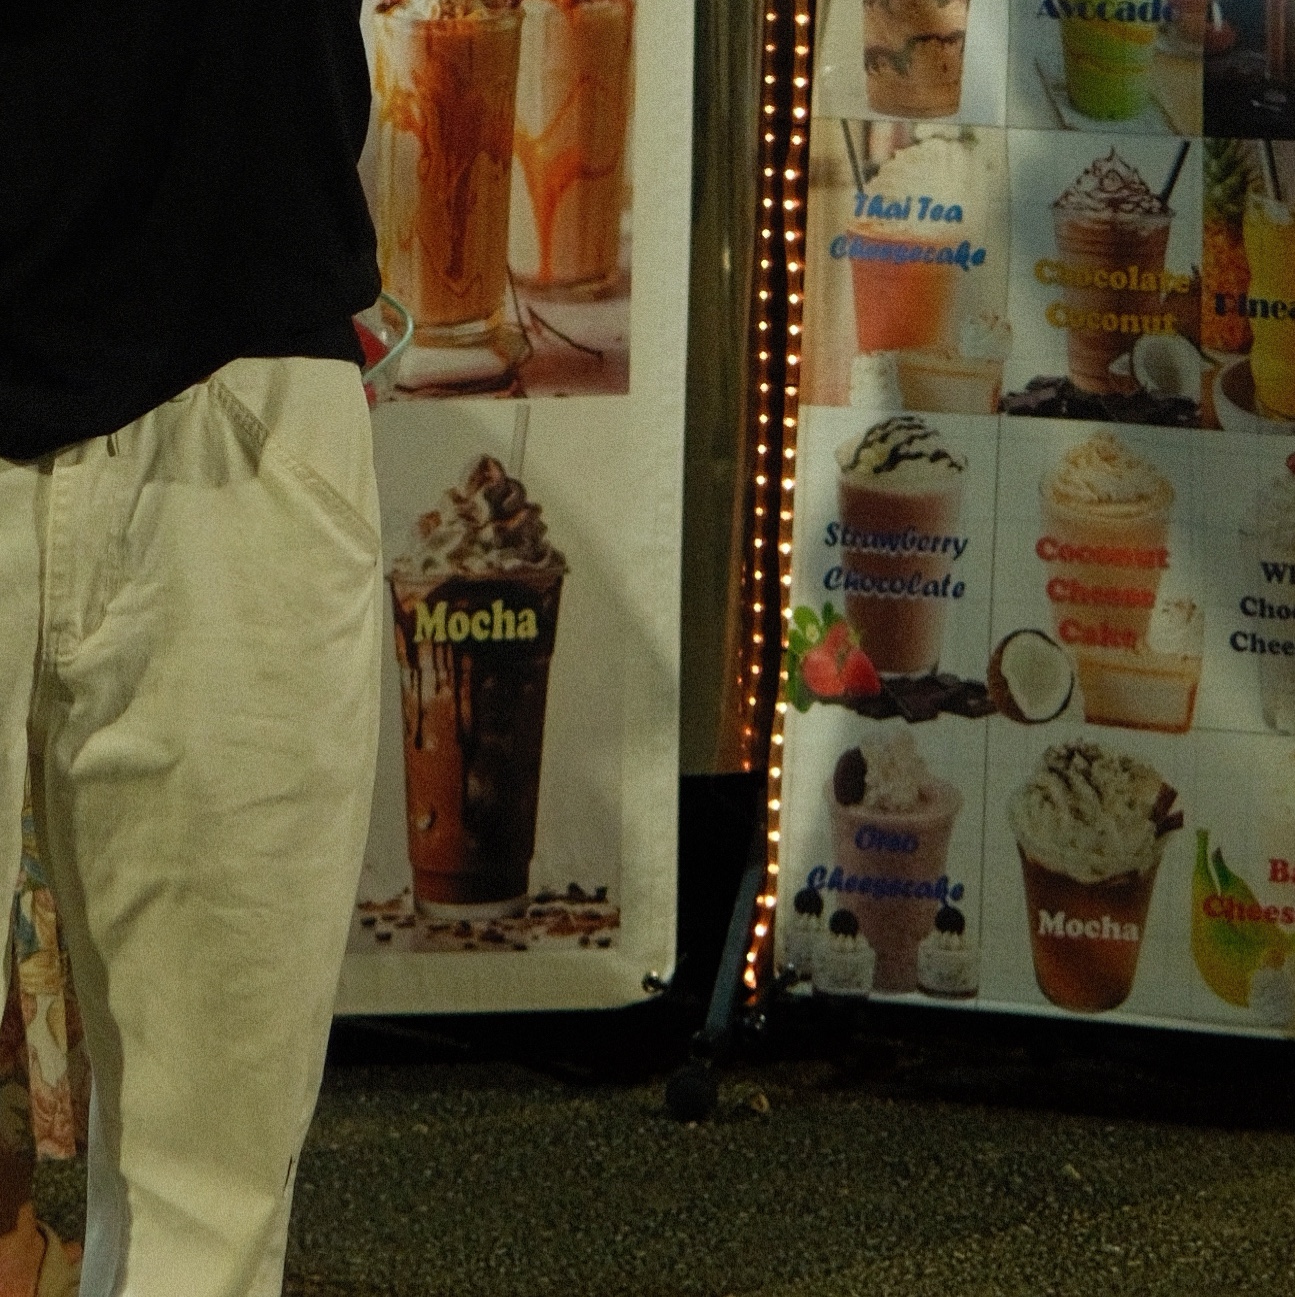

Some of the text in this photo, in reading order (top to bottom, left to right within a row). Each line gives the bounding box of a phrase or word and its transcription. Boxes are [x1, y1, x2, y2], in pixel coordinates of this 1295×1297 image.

[852, 191, 965, 224] Thai Tea
[829, 233, 988, 272] Cheesecake
[1033, 258, 1192, 294] Chocolate
[1044, 305, 1179, 335] Coconut
[823, 521, 969, 561] Strawberry
[823, 565, 967, 599] Chocolate
[412, 598, 539, 645] Mocha
[1057, 618, 1137, 650] Cake
[806, 864, 966, 907] Cheesecake
[1036, 909, 1142, 943] Mocha
